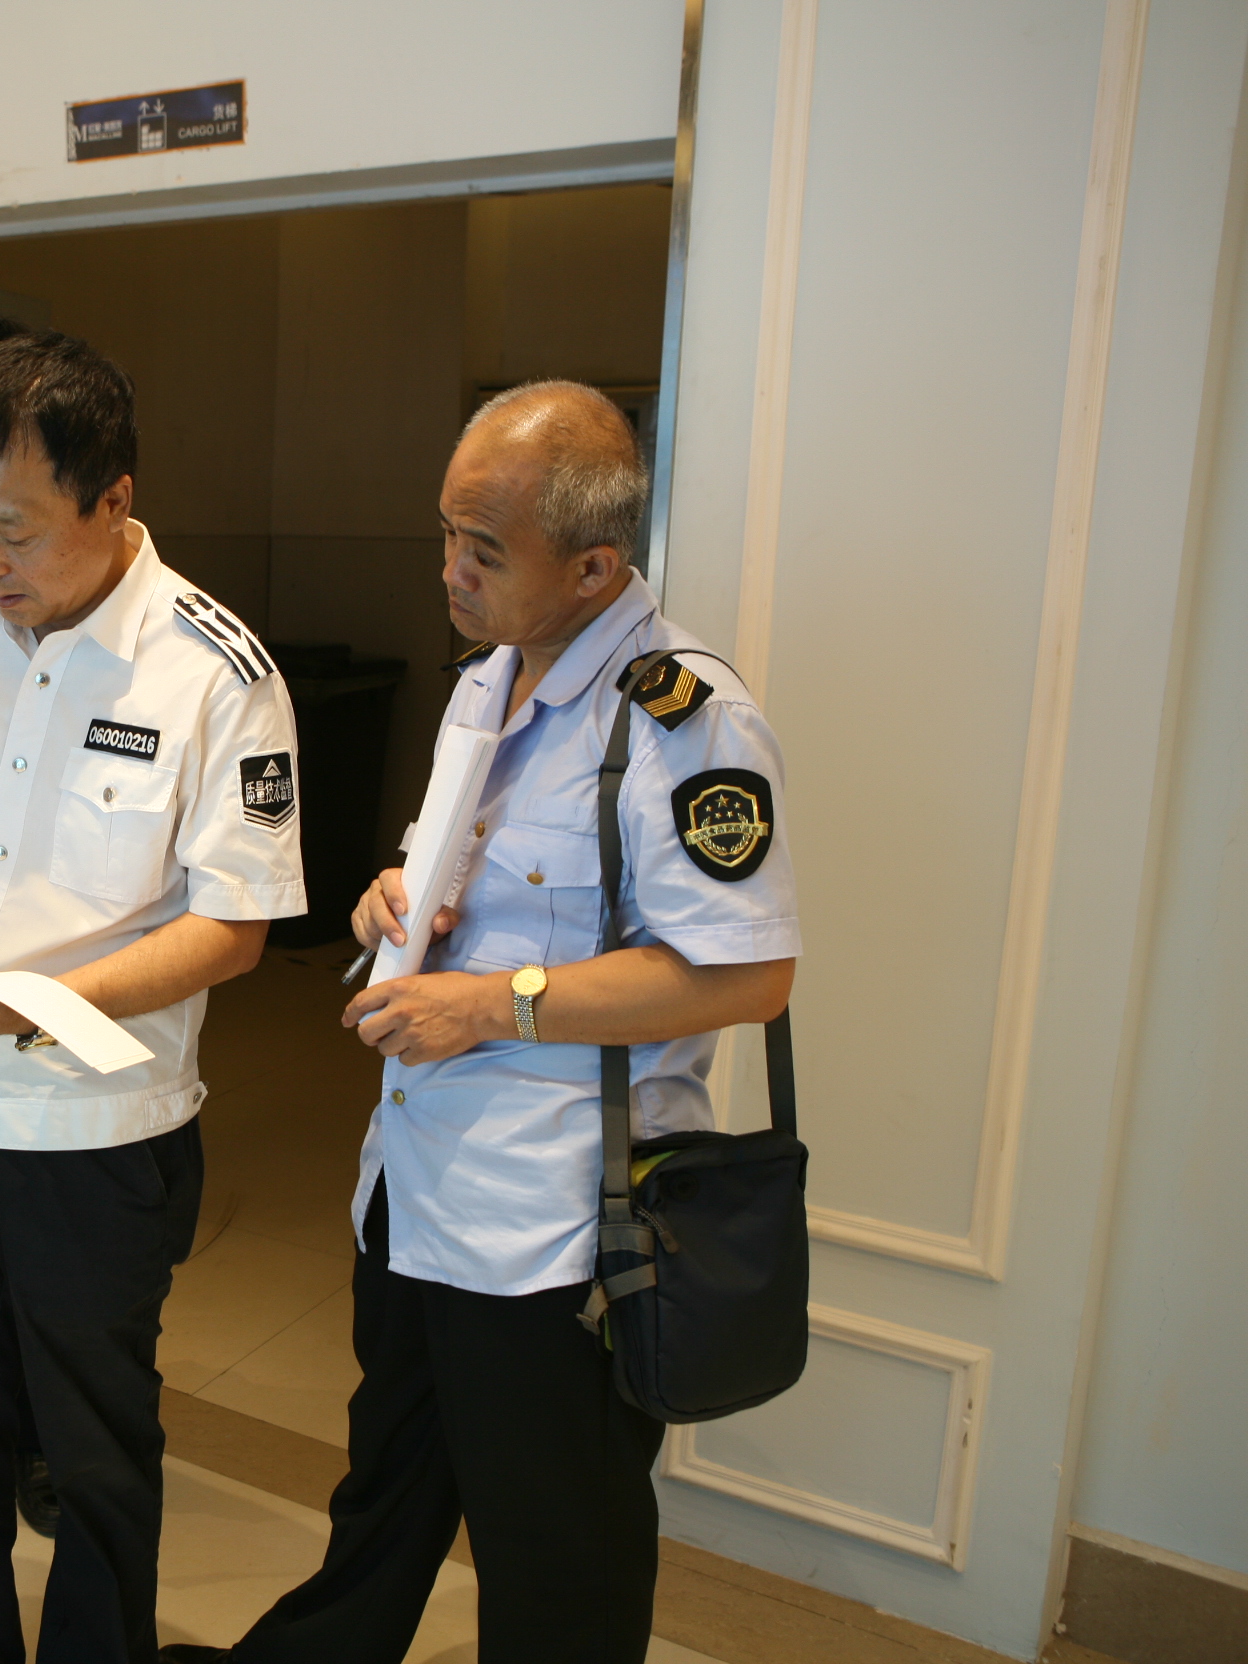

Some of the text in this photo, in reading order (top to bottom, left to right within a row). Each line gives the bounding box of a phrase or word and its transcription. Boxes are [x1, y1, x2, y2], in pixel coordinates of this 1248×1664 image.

[178, 121, 238, 139] CARGO LIFT
[88, 726, 155, 754] 060010216
[245, 777, 293, 805] 质量技术监督
